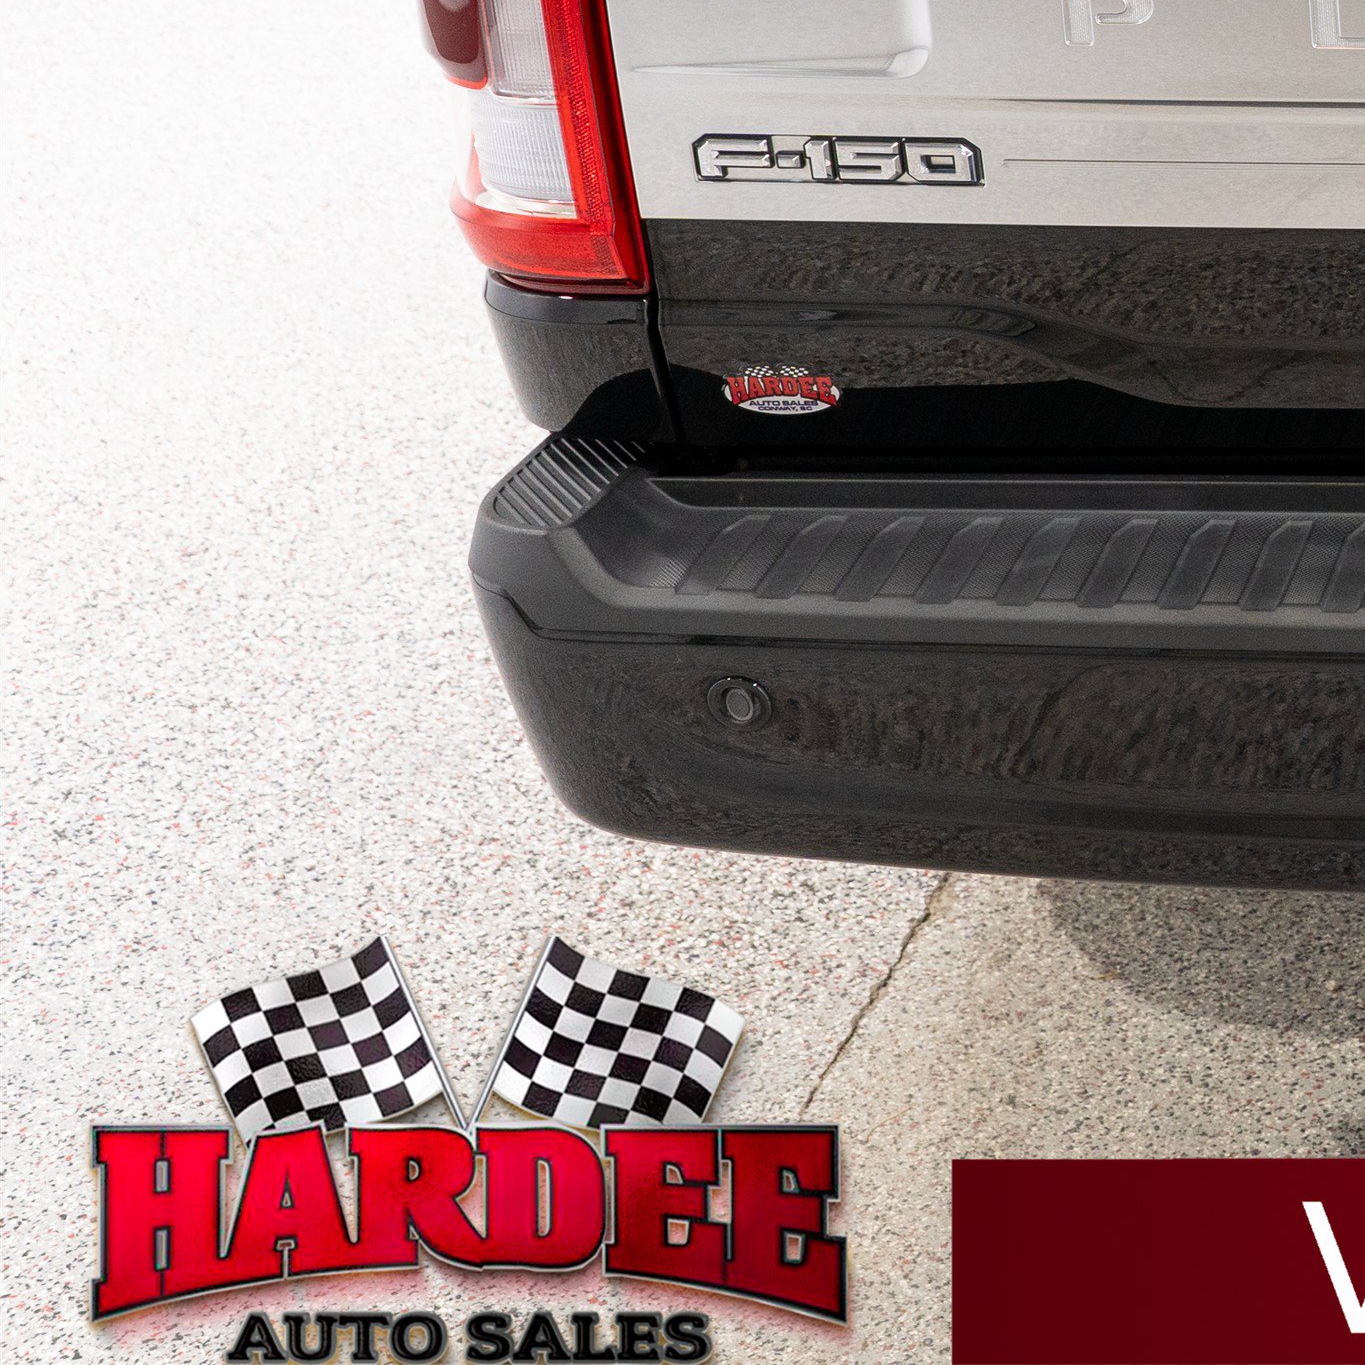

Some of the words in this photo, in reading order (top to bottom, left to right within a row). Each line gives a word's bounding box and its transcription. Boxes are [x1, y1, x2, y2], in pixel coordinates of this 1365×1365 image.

[692, 133, 986, 187] F-150
[726, 376, 838, 406] HARDEE
[750, 399, 780, 407] AUTO
